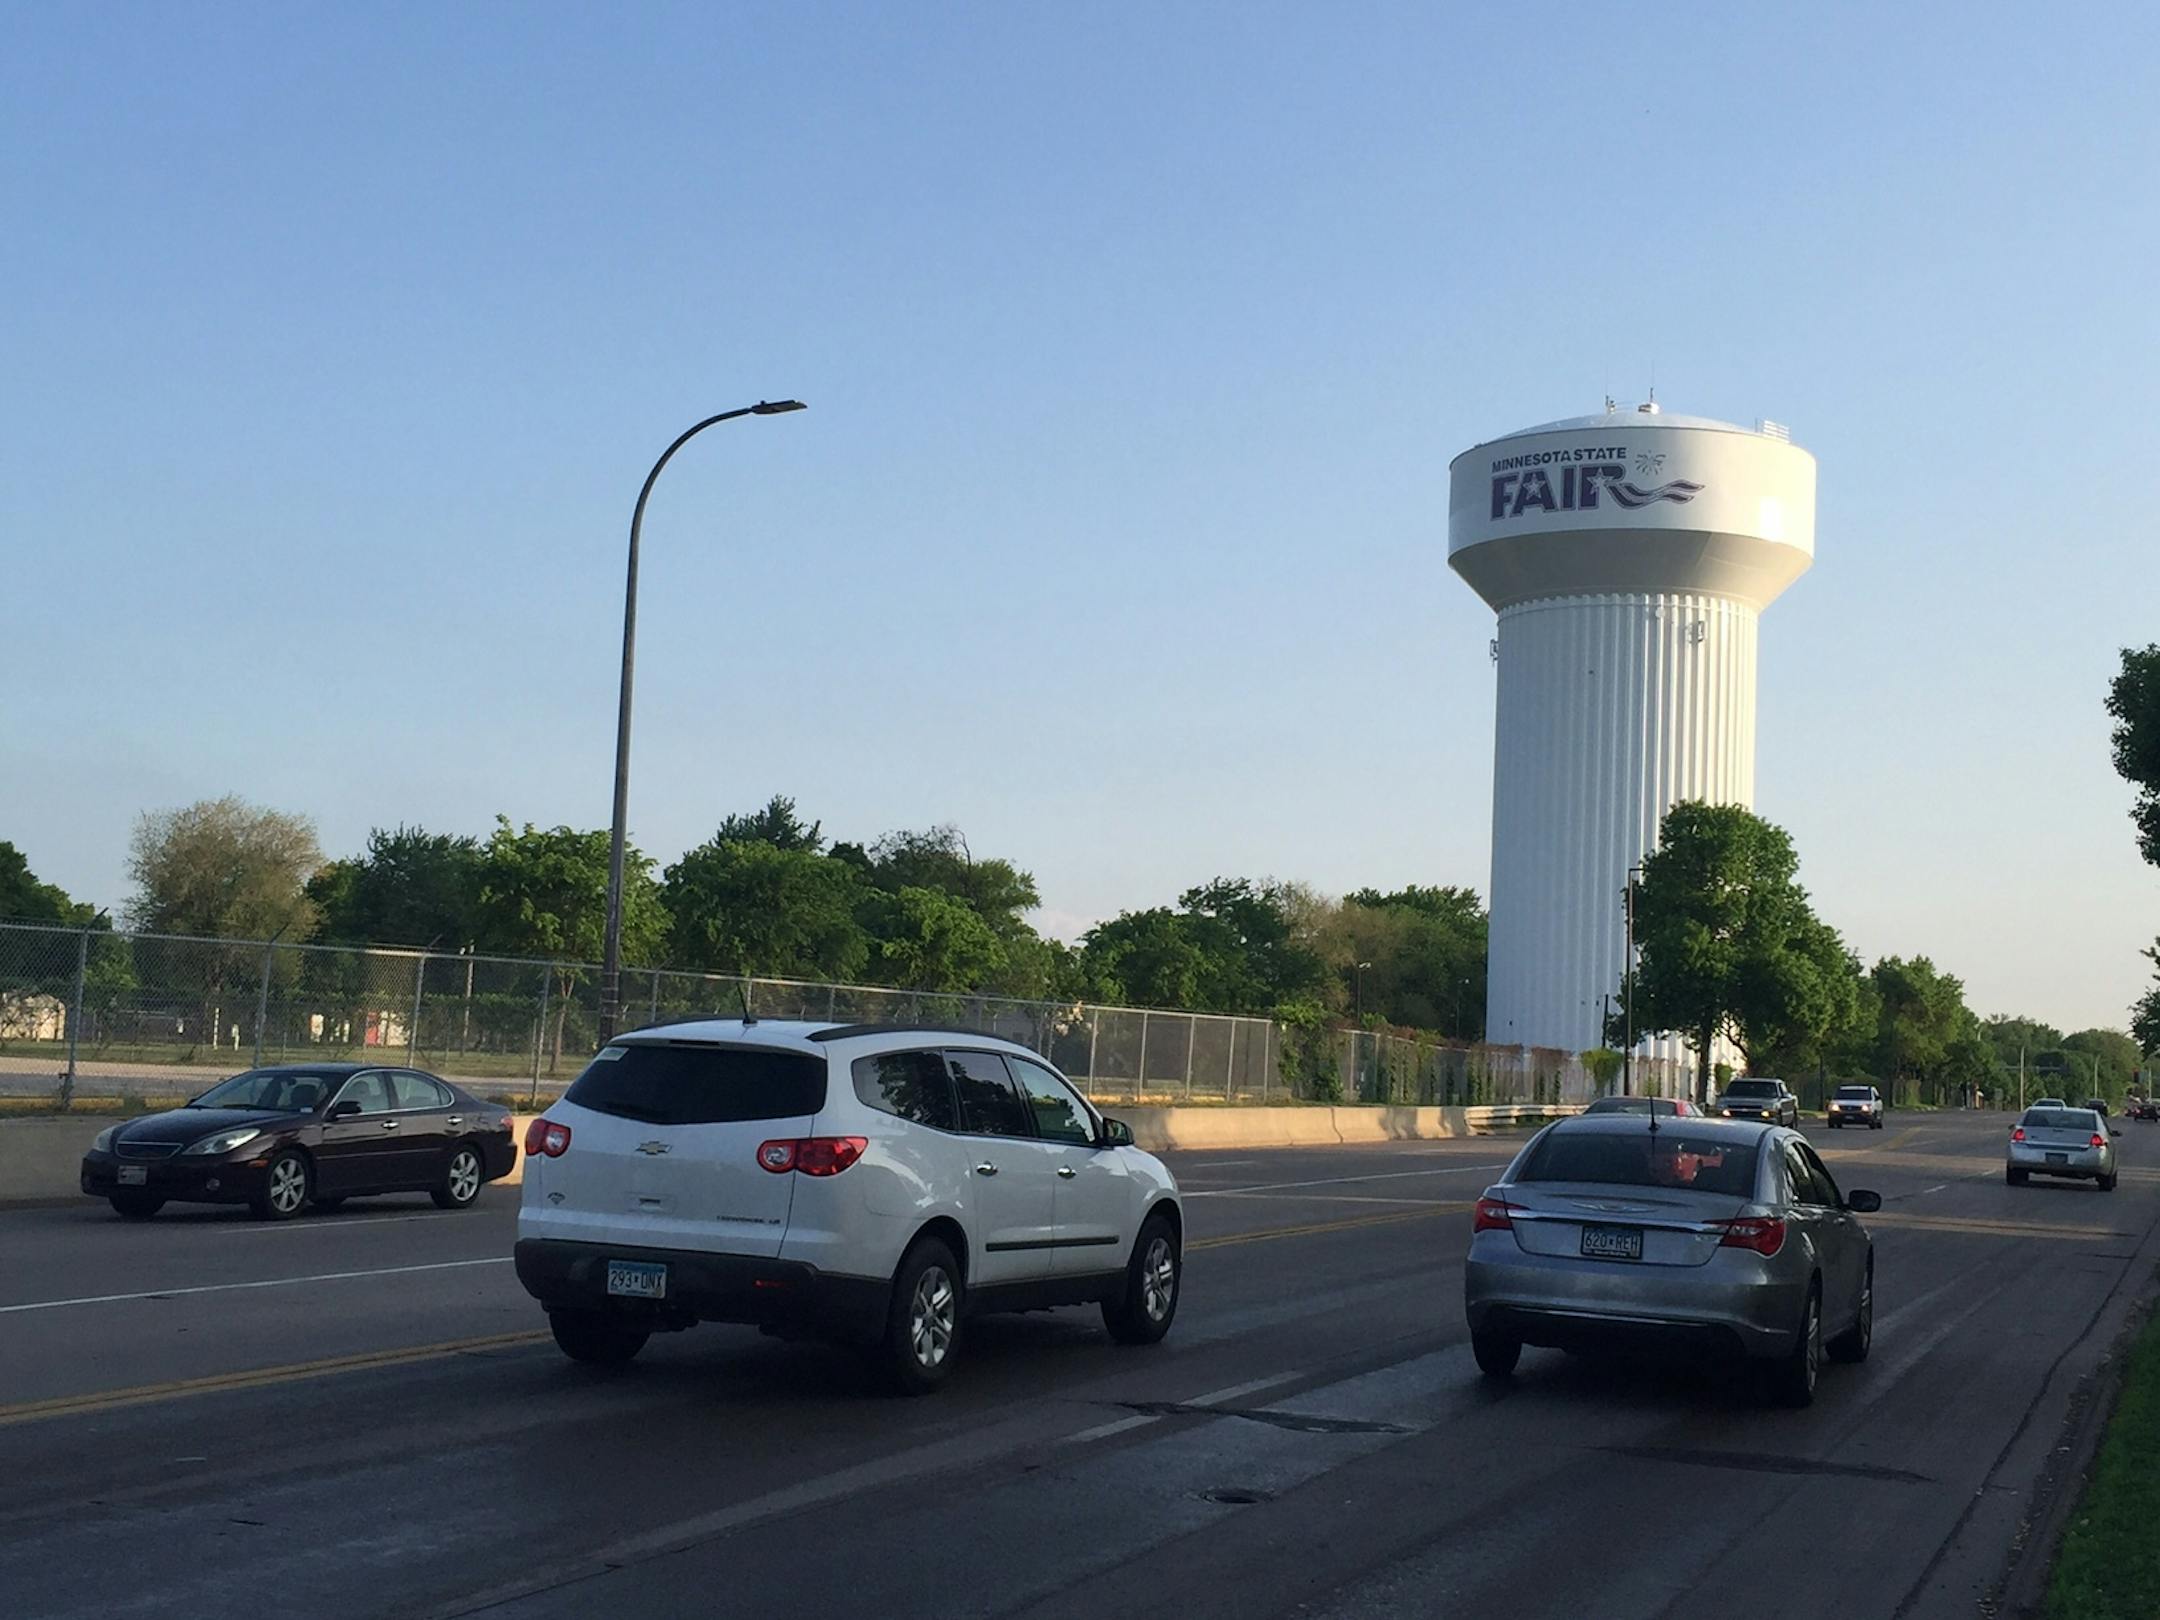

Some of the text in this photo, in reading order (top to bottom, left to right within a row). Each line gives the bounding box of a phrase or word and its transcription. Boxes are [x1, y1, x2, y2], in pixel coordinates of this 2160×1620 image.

[1491, 446, 1628, 474] MINNESOTA STATE
[1490, 462, 1640, 521] FAIR
